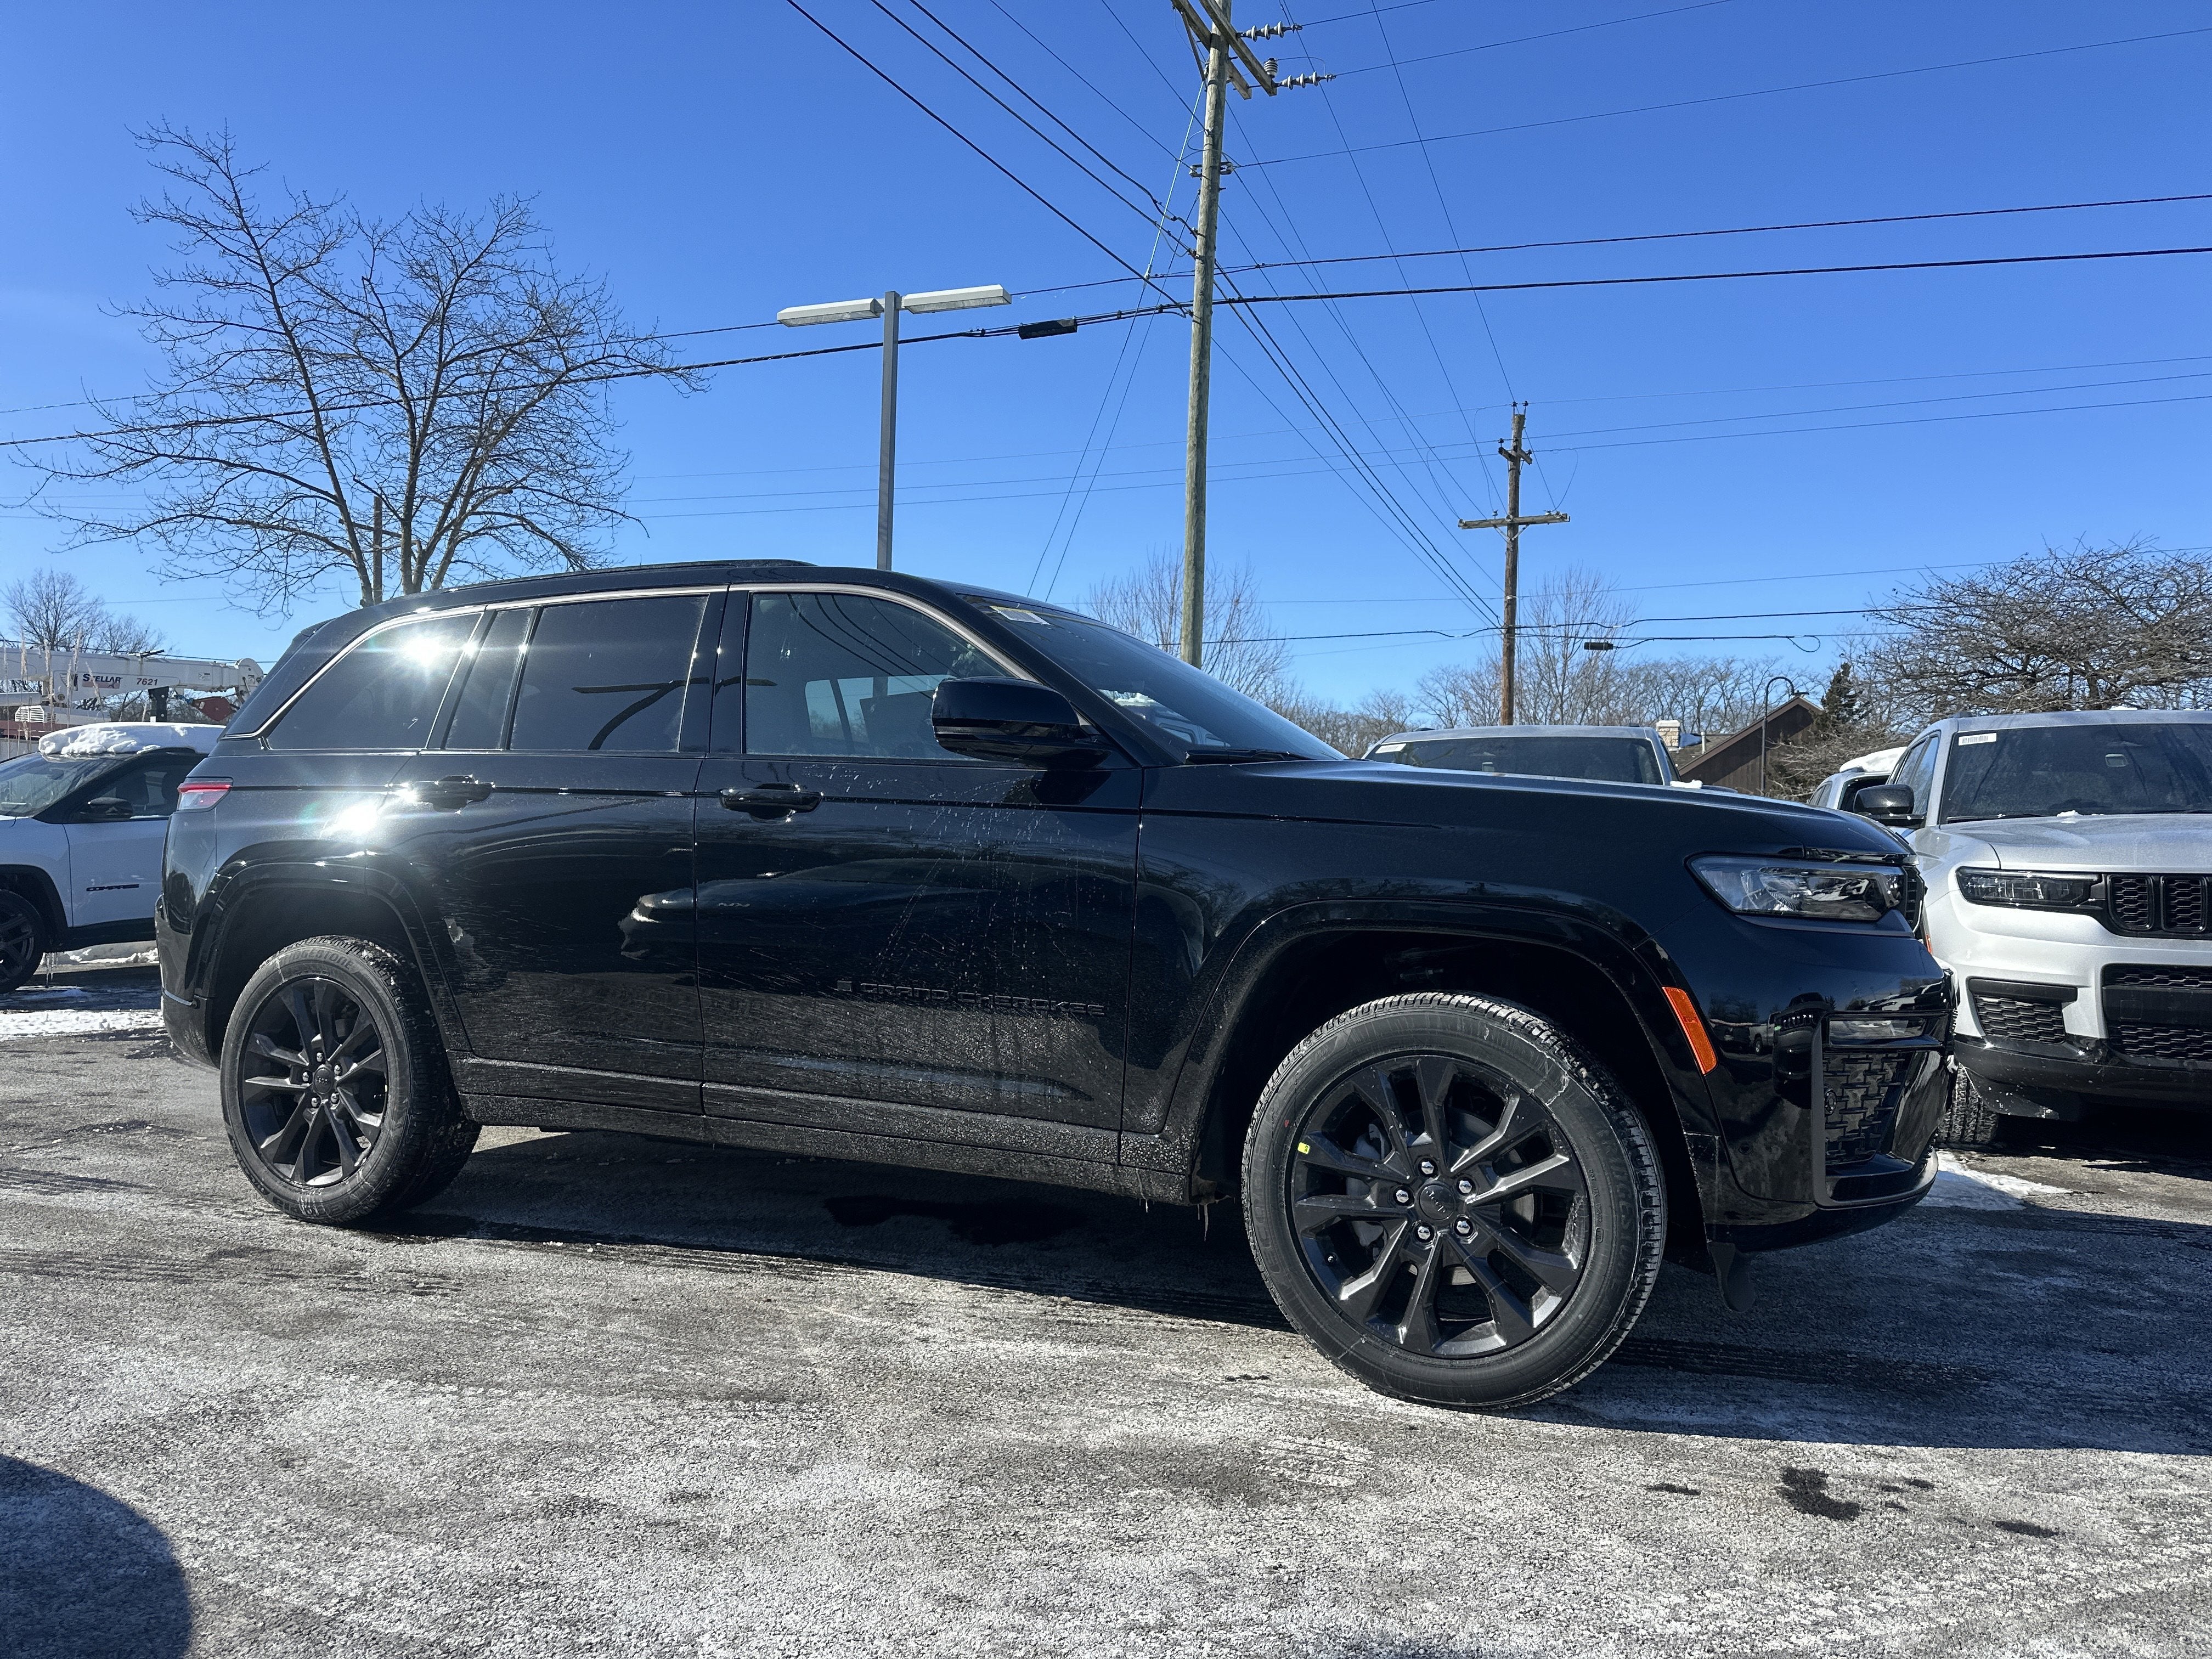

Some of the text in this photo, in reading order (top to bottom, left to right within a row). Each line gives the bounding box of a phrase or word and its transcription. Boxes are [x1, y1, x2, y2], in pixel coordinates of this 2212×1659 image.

[136, 678, 158, 686] 7621
[860, 983, 1105, 1016] GRAND CHEROKEE
